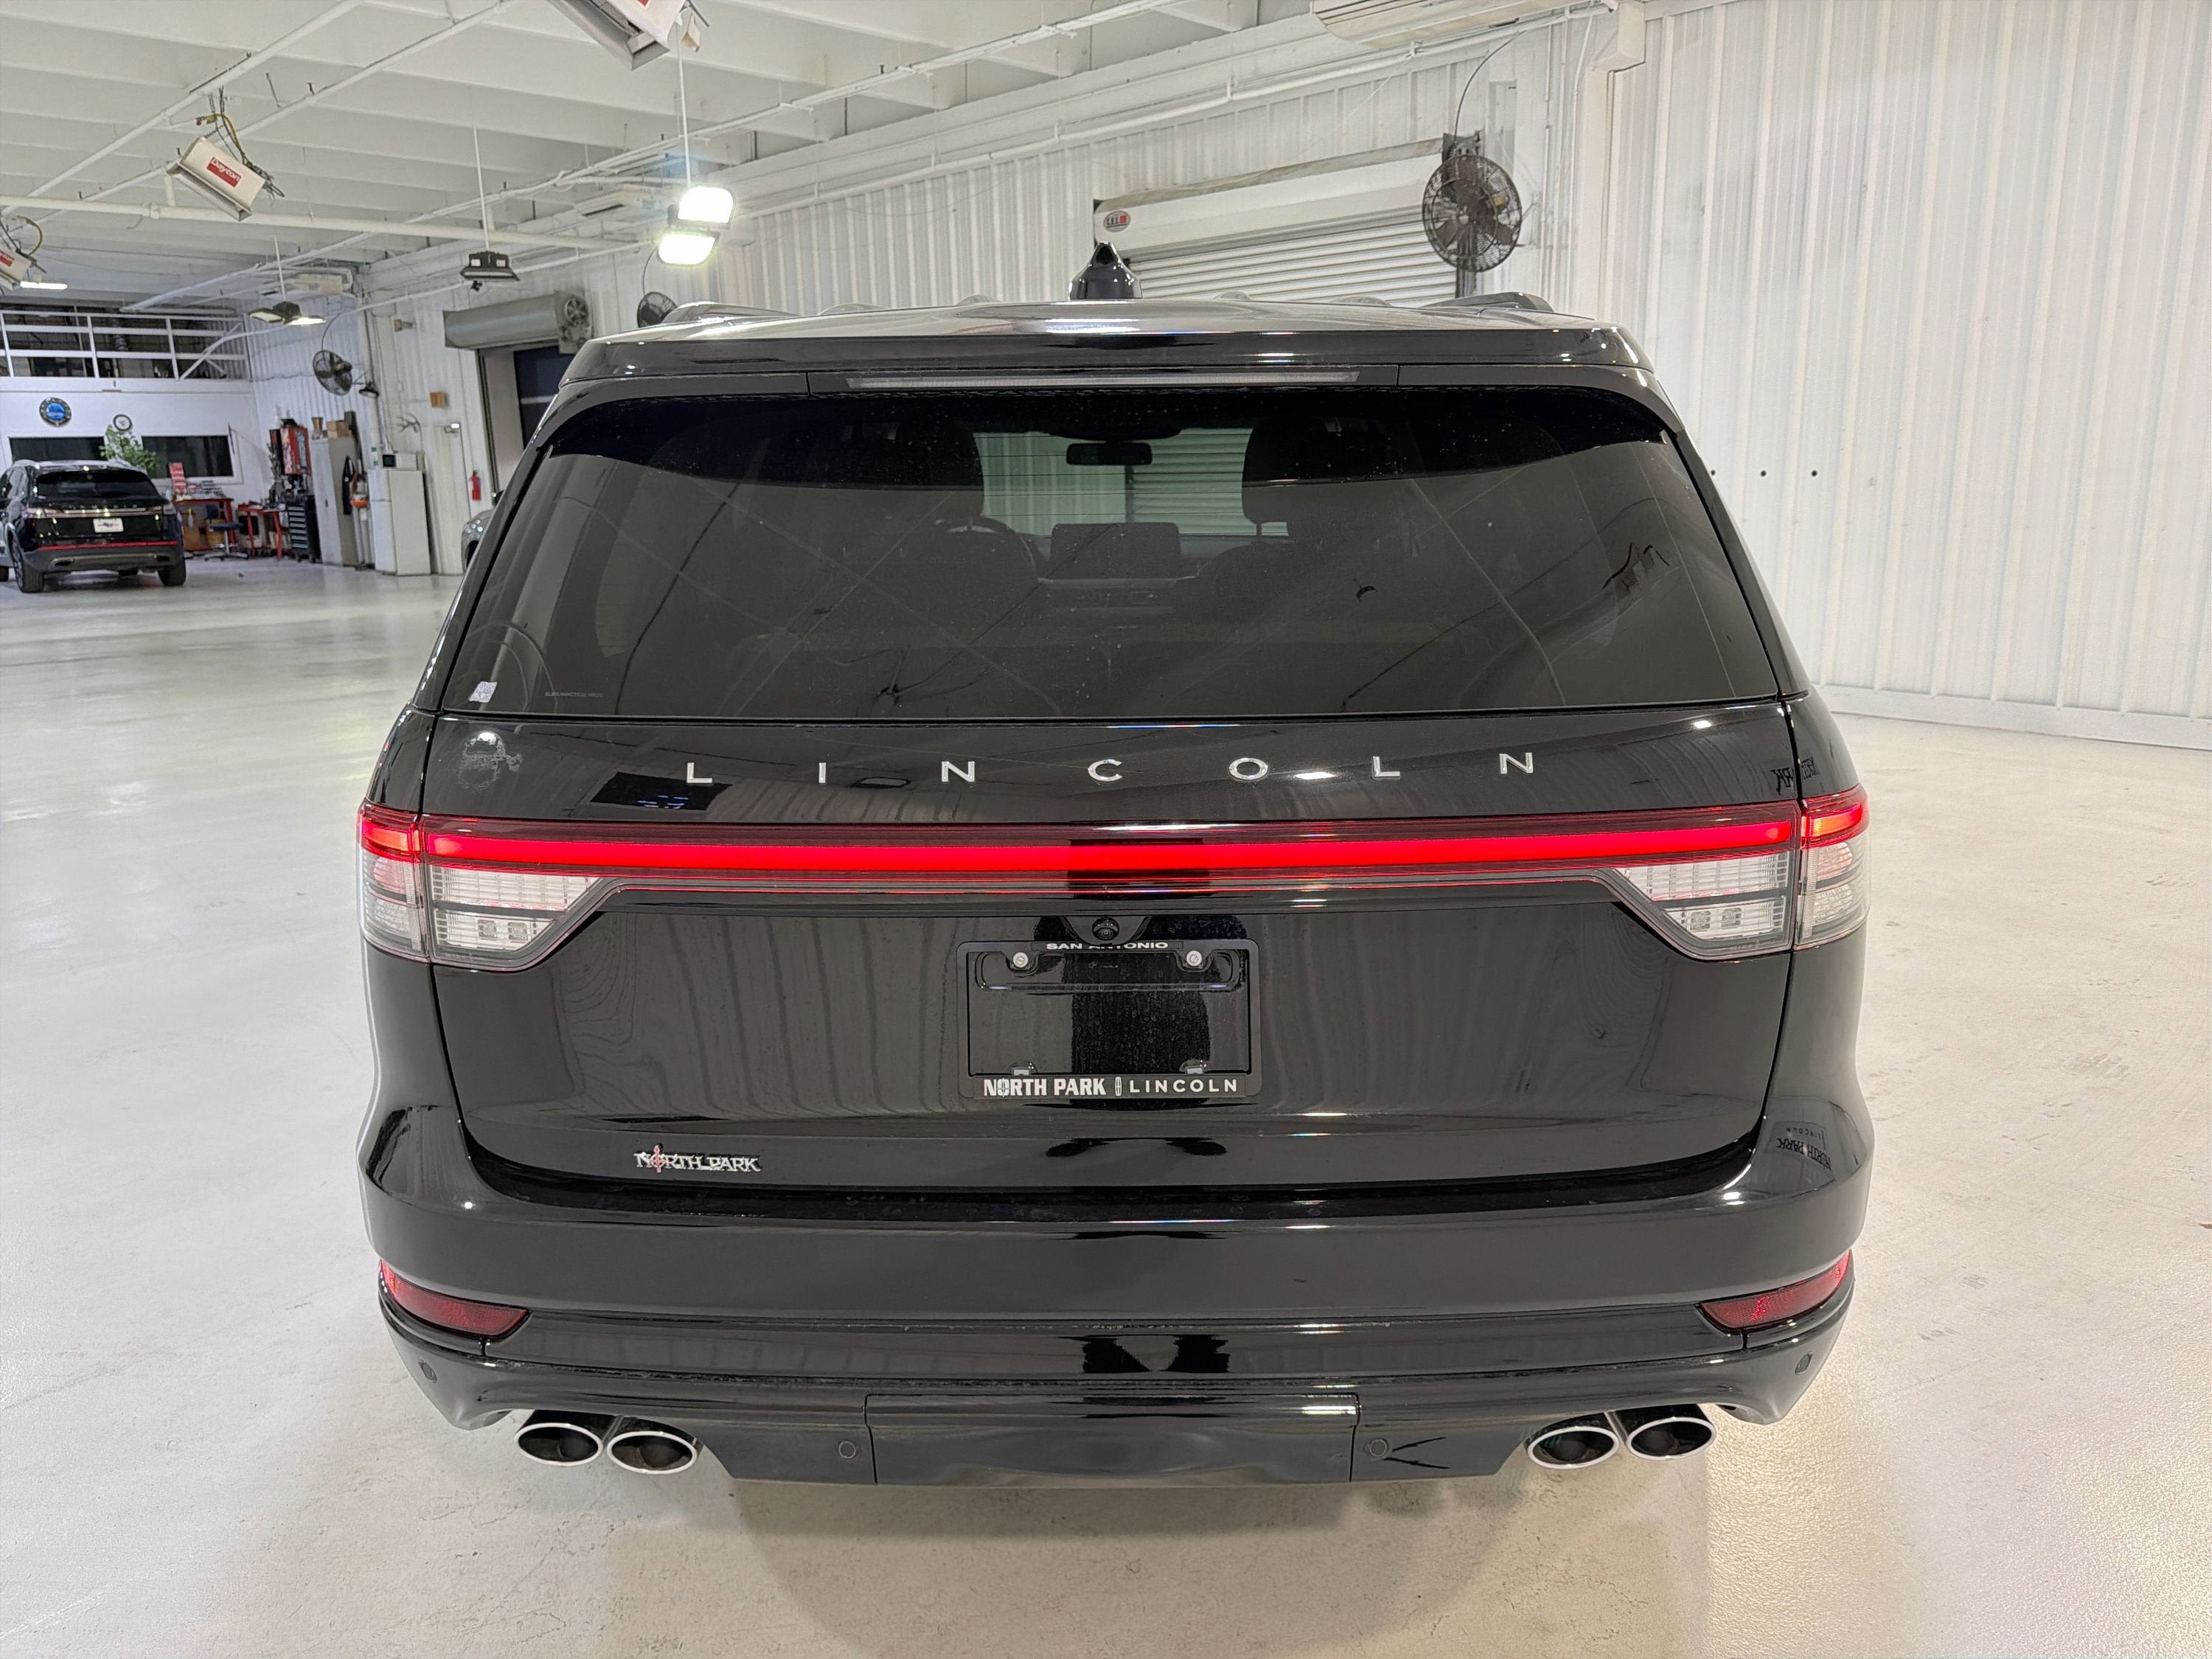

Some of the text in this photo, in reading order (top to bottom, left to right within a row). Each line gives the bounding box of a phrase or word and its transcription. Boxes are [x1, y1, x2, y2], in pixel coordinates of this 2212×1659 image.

[686, 752, 1534, 784] LINCOLN
[984, 1078, 1237, 1097] NORTH PARK LINCOLN
[633, 1147, 761, 1172] NORTH PARK
